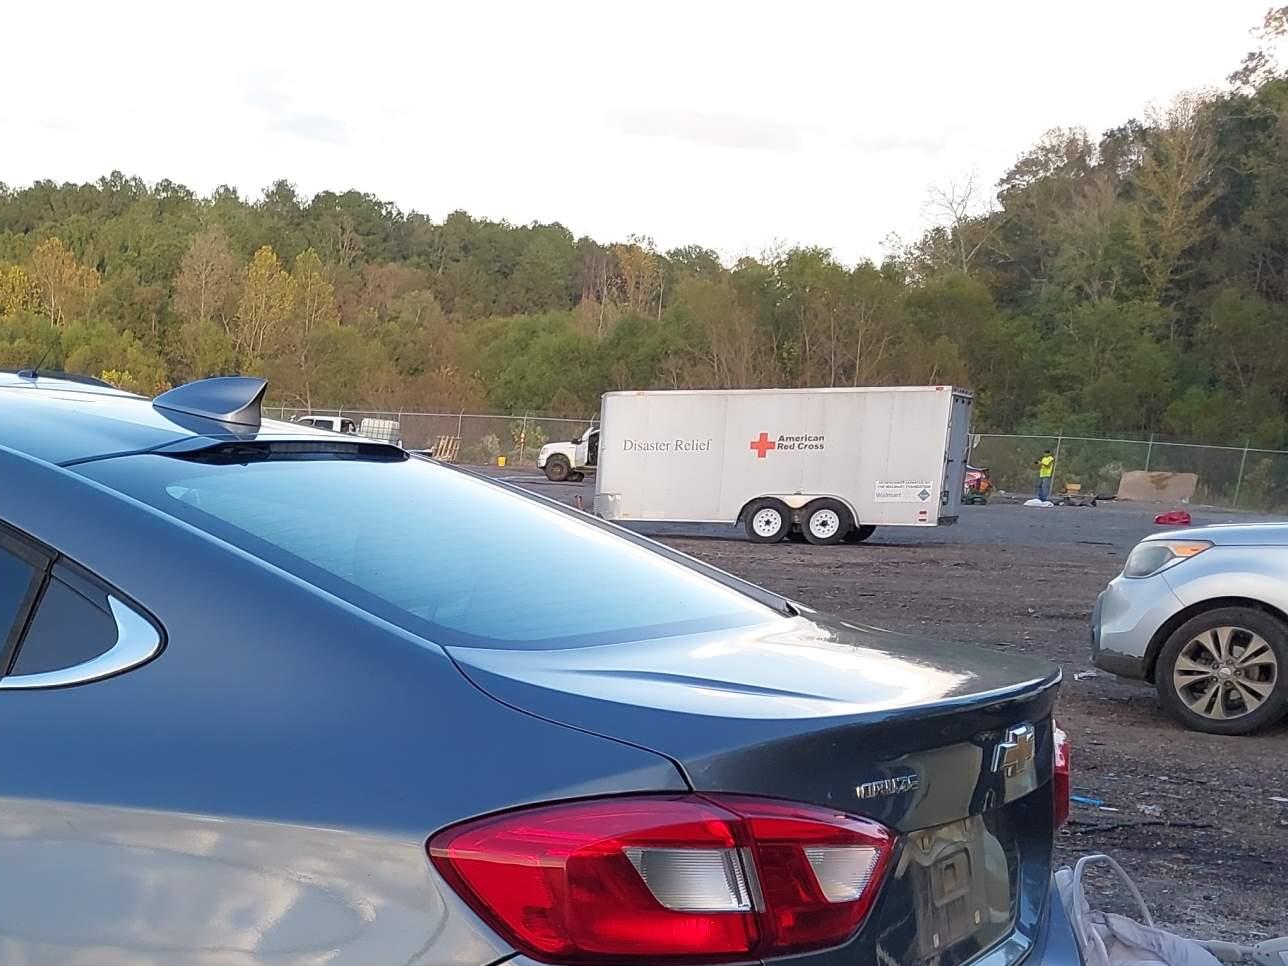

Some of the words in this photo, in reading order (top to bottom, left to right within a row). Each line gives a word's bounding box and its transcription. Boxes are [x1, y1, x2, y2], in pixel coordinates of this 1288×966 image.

[778, 434, 824, 442] American
[623, 439, 672, 451] Disaster
[674, 438, 712, 451] Relief
[777, 442, 795, 450] Red
[797, 442, 824, 450] Cross
